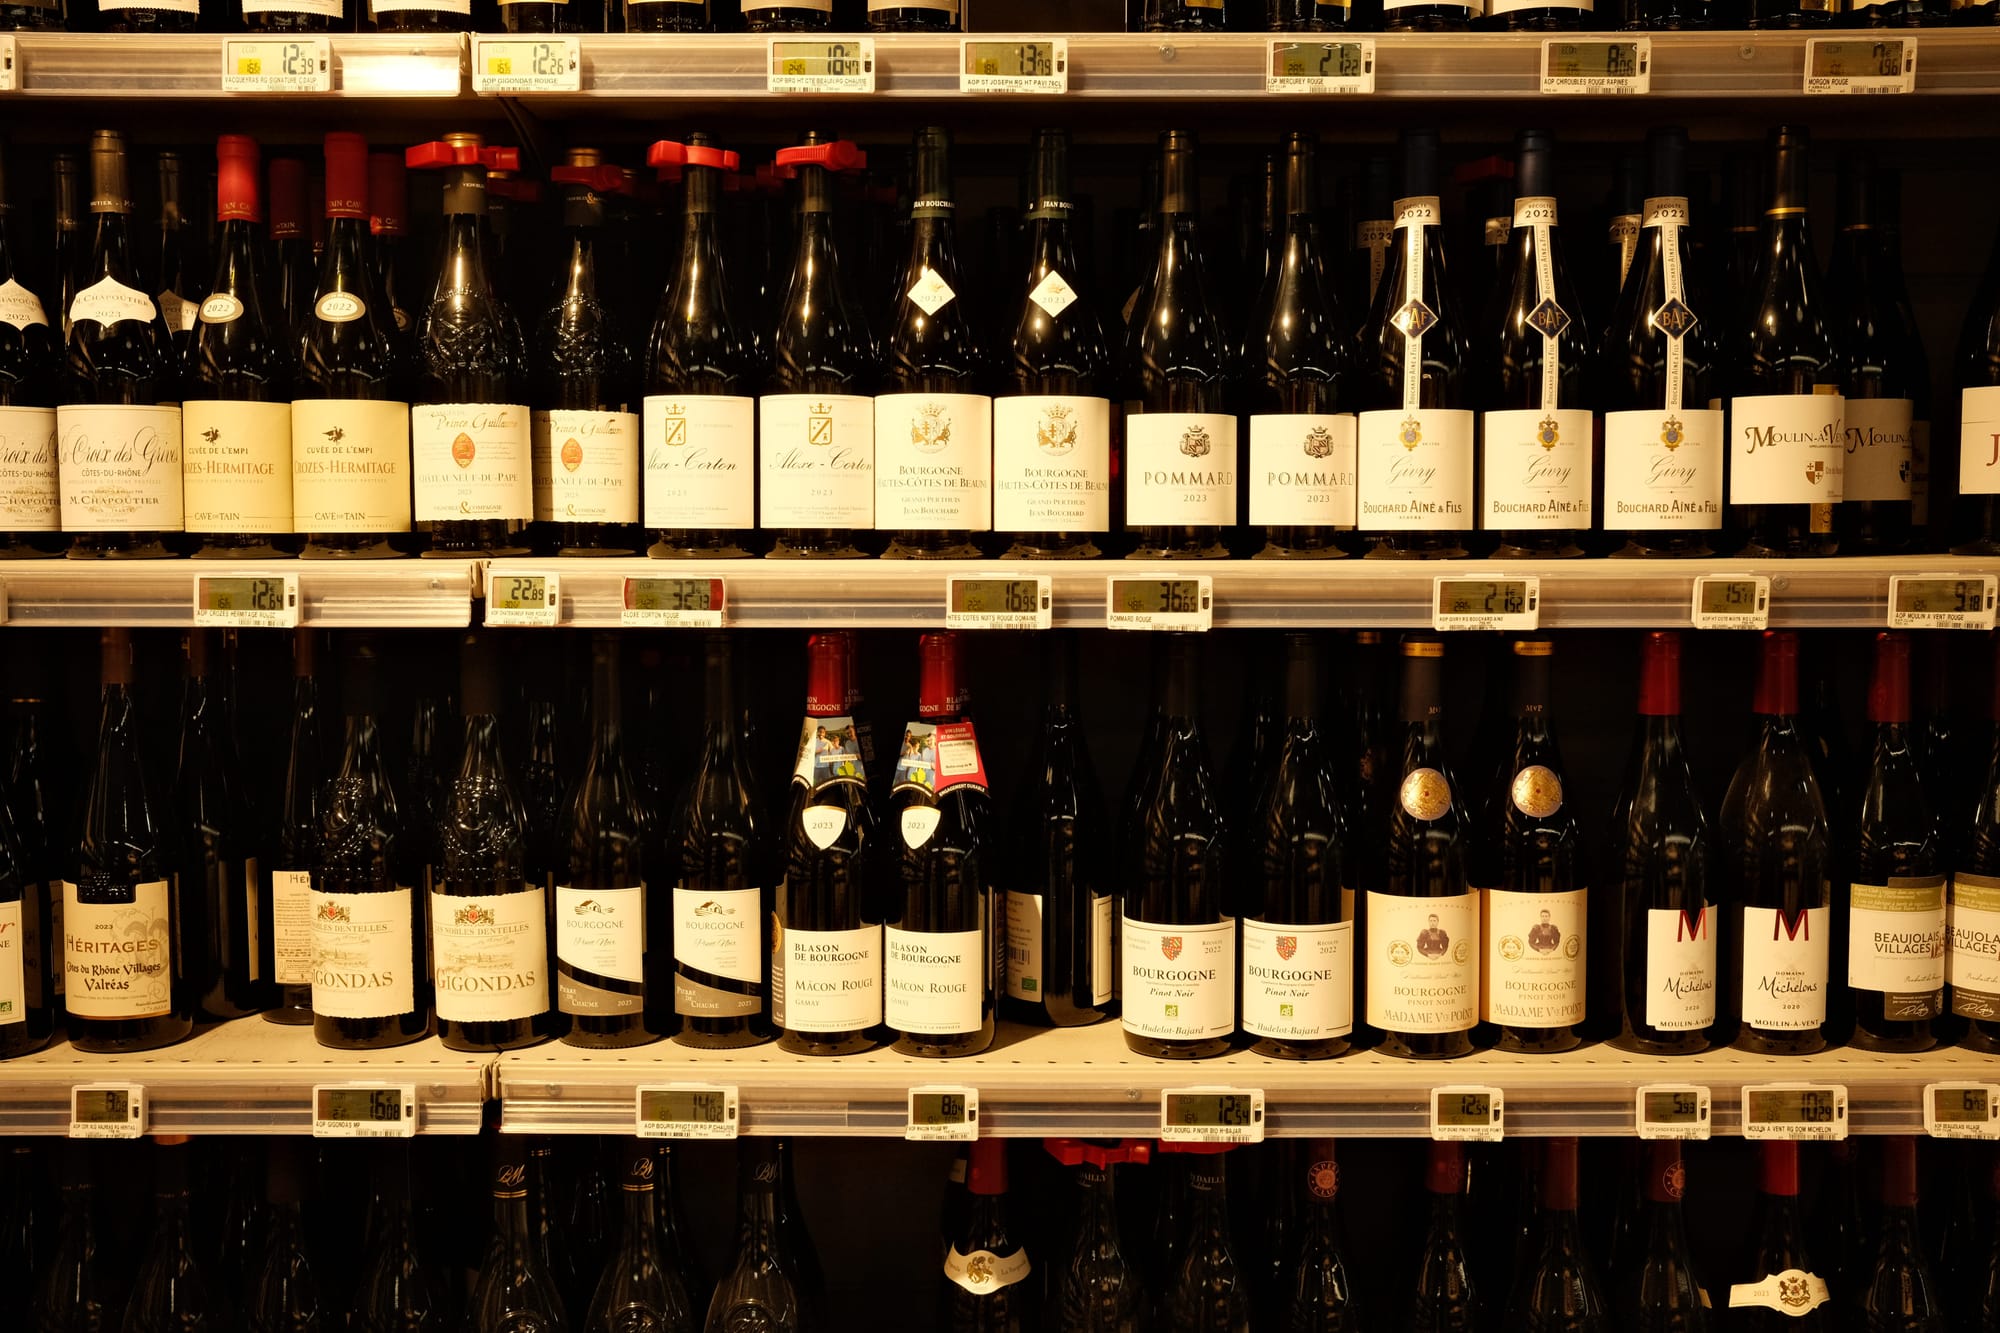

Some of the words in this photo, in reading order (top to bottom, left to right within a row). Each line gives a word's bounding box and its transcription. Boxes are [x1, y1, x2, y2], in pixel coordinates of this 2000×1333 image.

[1400, 209, 1432, 220] 2022
[1525, 209, 1555, 219] 2022
[1653, 209, 1685, 219] 2022
[326, 302, 352, 311] 2022
[1538, 308, 1564, 327] BAF
[1662, 308, 1689, 328] BAF
[114, 441, 135, 465] des
[306, 446, 331, 454] CUVÉE
[333, 446, 344, 454] DE
[682, 446, 738, 471] Corton
[81, 467, 142, 478] CÔTES-DU-RHÔNE
[899, 465, 963, 476] BOURGOGNE
[1024, 468, 1089, 478] BOURGOGNE
[1386, 454, 1436, 484] Givry
[1522, 454, 1572, 484] Givry
[1644, 454, 1697, 484] Givry
[944, 480, 958, 489] DE
[1144, 471, 1233, 486] POMMARD
[1268, 472, 1353, 486] POMMARD
[1070, 482, 1084, 491] DE
[1183, 494, 1207, 503] 2023
[1307, 495, 1330, 503] 2023
[921, 507, 960, 515] BOUCHARD
[1364, 502, 1408, 514] BOUCHARD
[1446, 500, 1462, 513] FILS
[1493, 501, 1546, 513] BOUCHARD
[1617, 501, 1668, 513] BOUCHARD
[1704, 499, 1718, 513] FILS
[194, 513, 213, 521] CAVE
[219, 512, 240, 521] TAIN
[314, 512, 337, 521] CAVE
[345, 512, 366, 521] TAIN
[1047, 509, 1085, 517] BOUCHARD
[812, 822, 834, 830] 2023
[566, 920, 624, 930] BOURGOGNE
[686, 921, 745, 930] BOURGOGNE
[1677, 909, 1708, 942] M
[1773, 909, 1809, 942] M
[1874, 931, 1940, 944] BEAUJOLAIS
[66, 934, 159, 954] HÉRITAGES
[794, 943, 840, 953] BLASON
[890, 941, 928, 954] BLASON
[1204, 946, 1222, 954] 2022
[1319, 946, 1337, 954] 2022
[1874, 942, 1931, 954] VILLAGES
[1946, 938, 1997, 954] VILLAGES
[794, 953, 807, 962] DE
[809, 950, 870, 962] BOURGOGNE
[890, 952, 899, 961] DE
[901, 953, 962, 964] BOURGOGNE
[92, 963, 121, 977] Rhône
[123, 962, 161, 975] Villages
[1132, 965, 1217, 981] BOURGOGNE
[1248, 965, 1332, 981] BOURGOGNE
[84, 978, 130, 990] Valréas
[437, 969, 536, 992] GIGONDAS
[794, 979, 837, 992] MÂCON
[842, 977, 874, 991] ROUGE
[891, 978, 925, 992] MÂCON
[929, 981, 968, 993] ROUGE
[1505, 980, 1577, 991] BOURGOGNE
[1149, 987, 1172, 998] Pinot
[1174, 988, 1195, 998] Noir
[1264, 987, 1287, 998] Pinot
[1289, 988, 1310, 998] Noir
[1394, 984, 1467, 996] BOURGOGNE
[1663, 976, 1713, 1000] Michelons
[1758, 975, 1818, 1000] Michelons
[1436, 998, 1456, 1006] NOIR
[1545, 993, 1566, 1001] NOIR
[571, 999, 599, 1008] CHAUME
[691, 1000, 720, 1009] CHAUME
[1384, 1008, 1433, 1024] MADAME
[1494, 1002, 1544, 1018] MADAME
[1754, 1018, 1819, 1028] MOULIN-À-VENT
